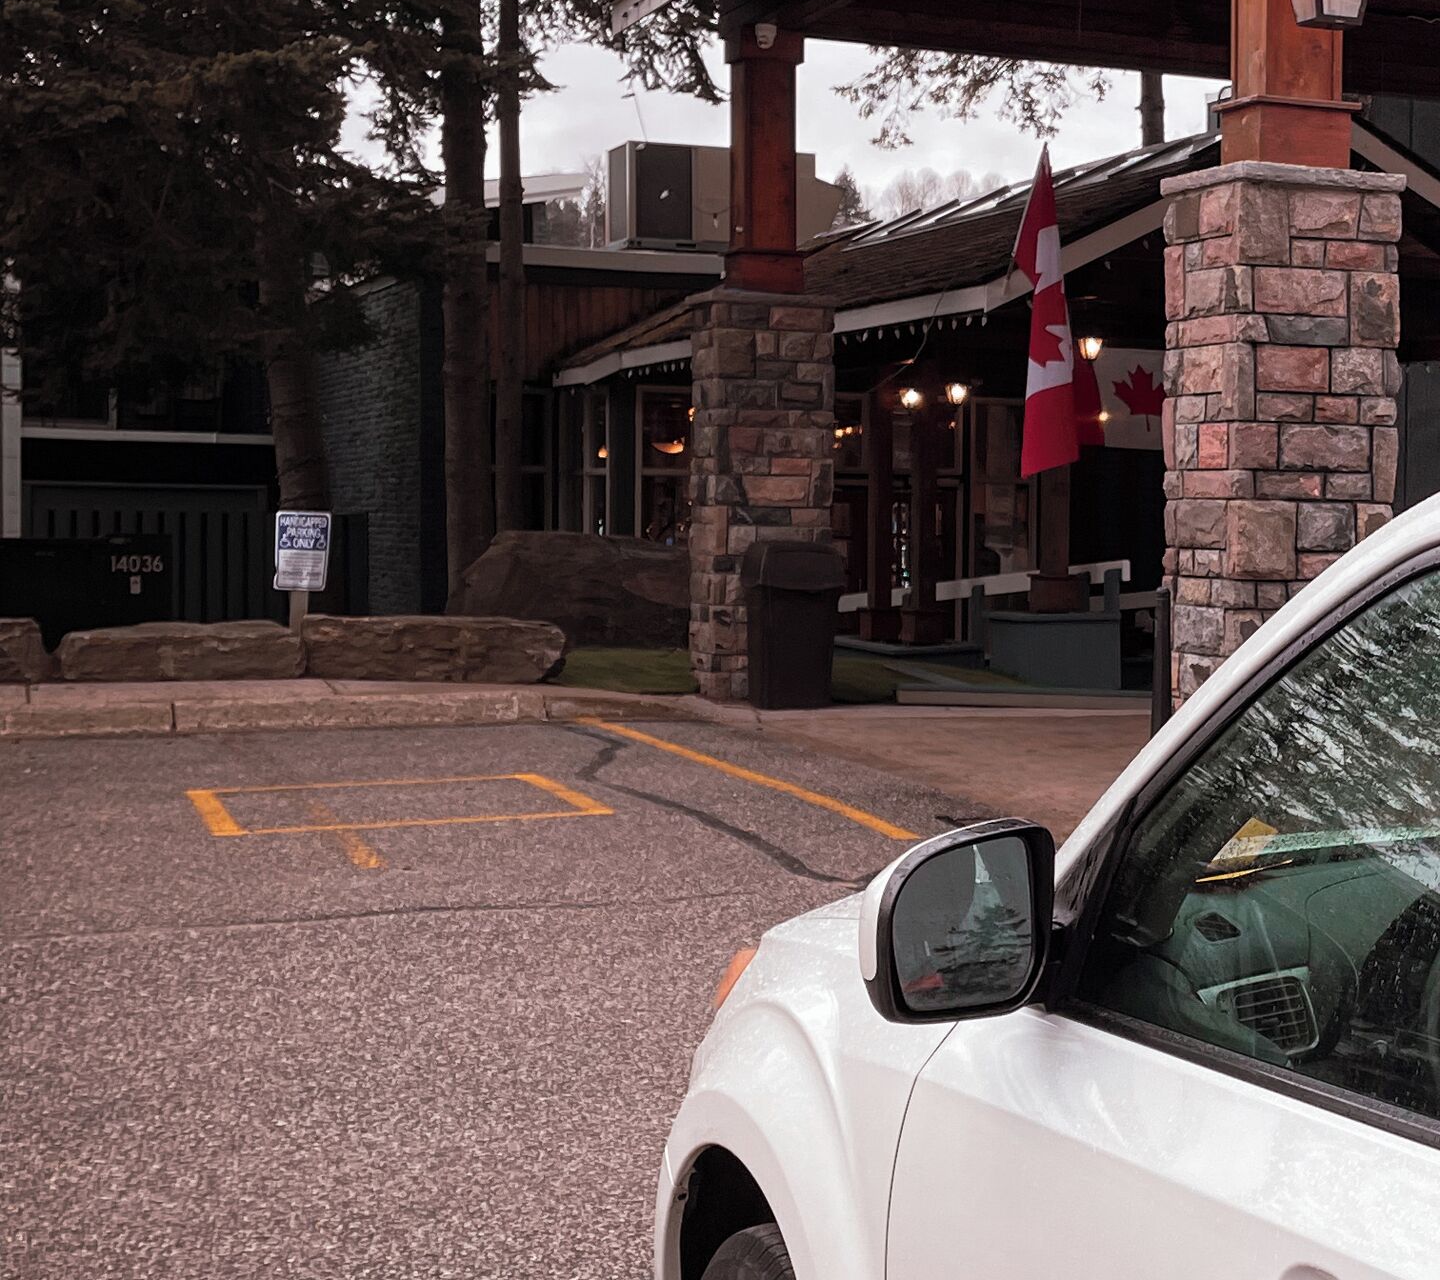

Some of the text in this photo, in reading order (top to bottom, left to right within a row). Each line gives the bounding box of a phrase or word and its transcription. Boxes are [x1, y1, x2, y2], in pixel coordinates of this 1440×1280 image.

[280, 516, 328, 528] HANDICAPPED
[286, 527, 321, 538] PARKING
[292, 538, 315, 549] ONLY
[111, 555, 163, 573] 14036
